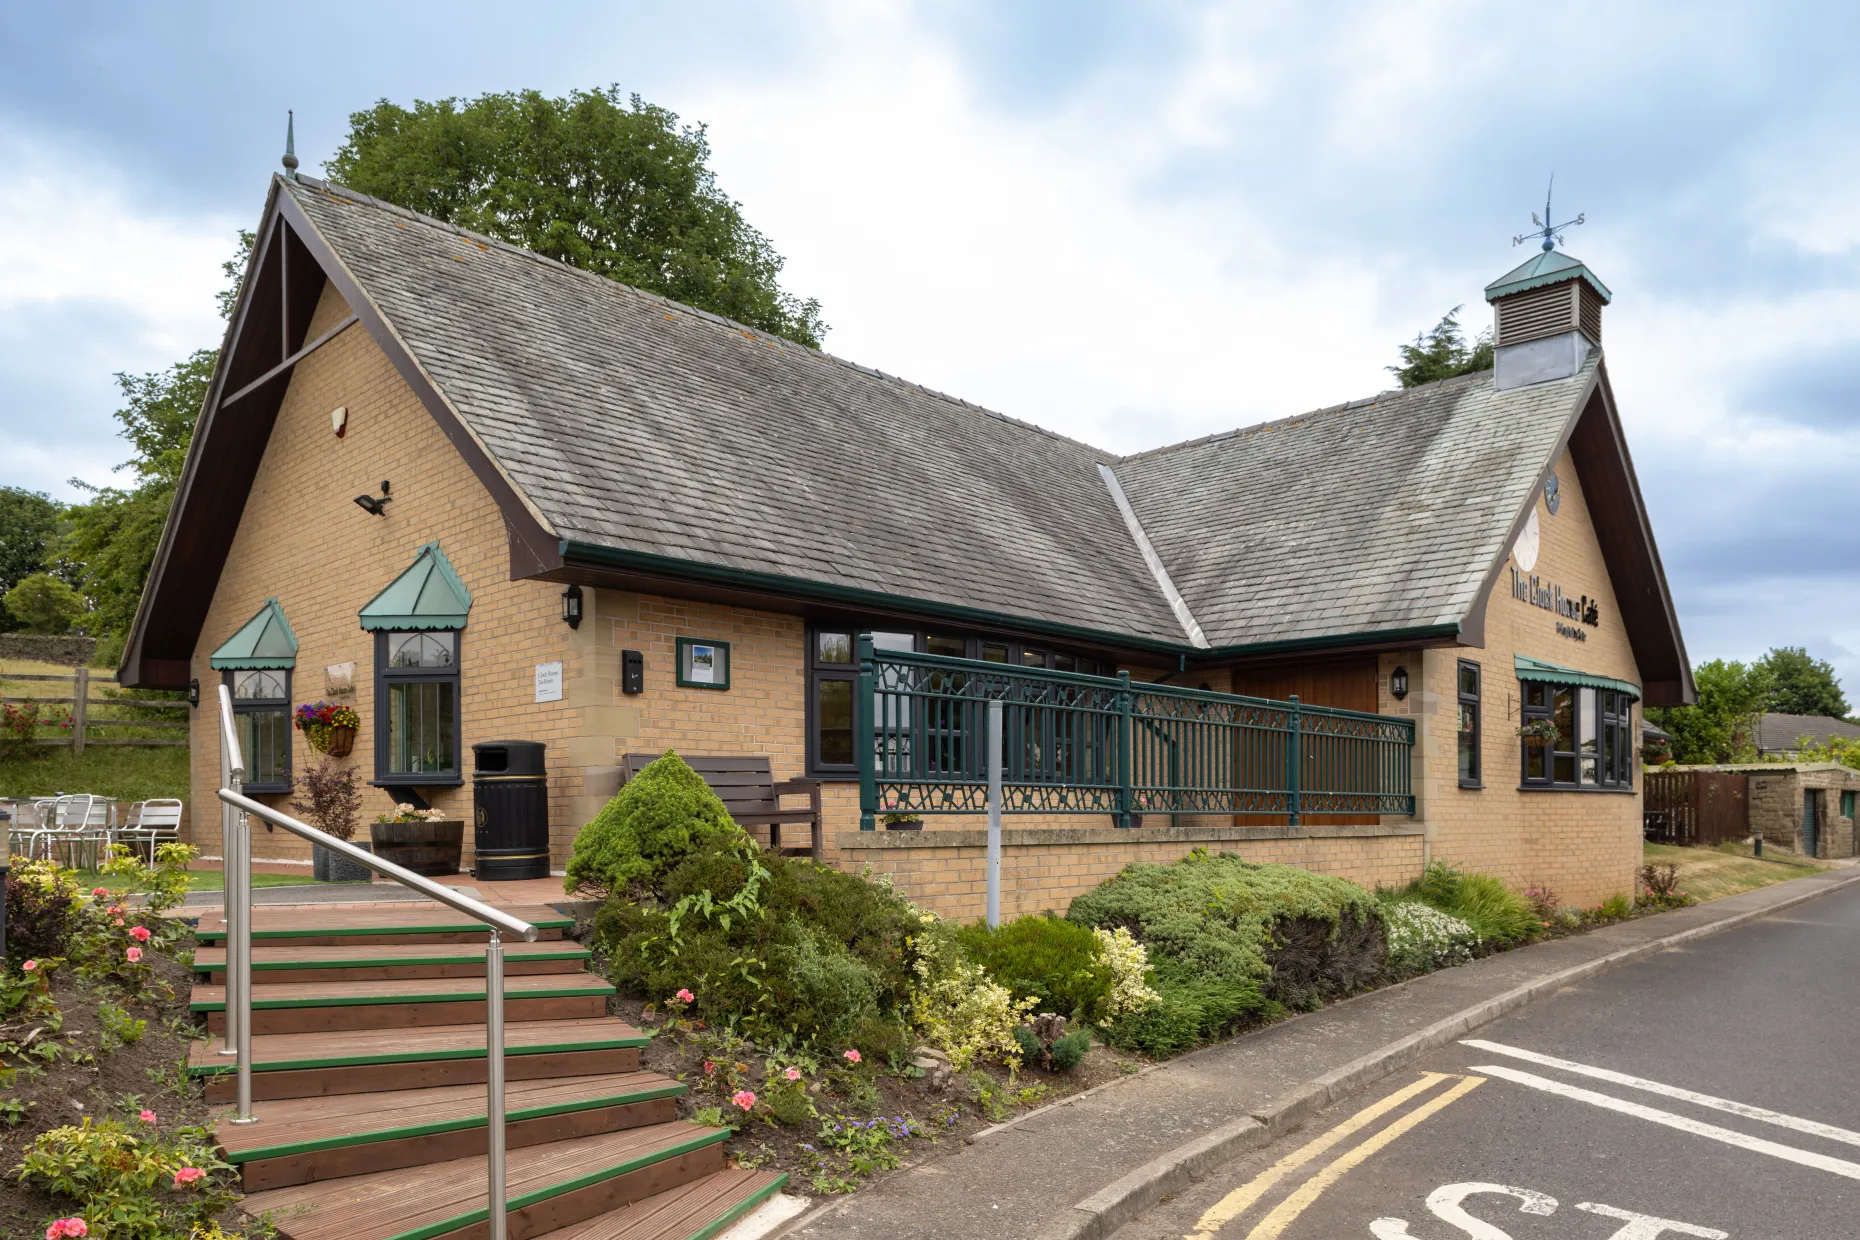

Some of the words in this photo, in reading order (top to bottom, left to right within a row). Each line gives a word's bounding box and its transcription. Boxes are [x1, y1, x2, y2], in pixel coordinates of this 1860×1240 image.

[1510, 566, 1528, 603] The
[1530, 574, 1553, 613] Clock
[1555, 583, 1580, 622] House
